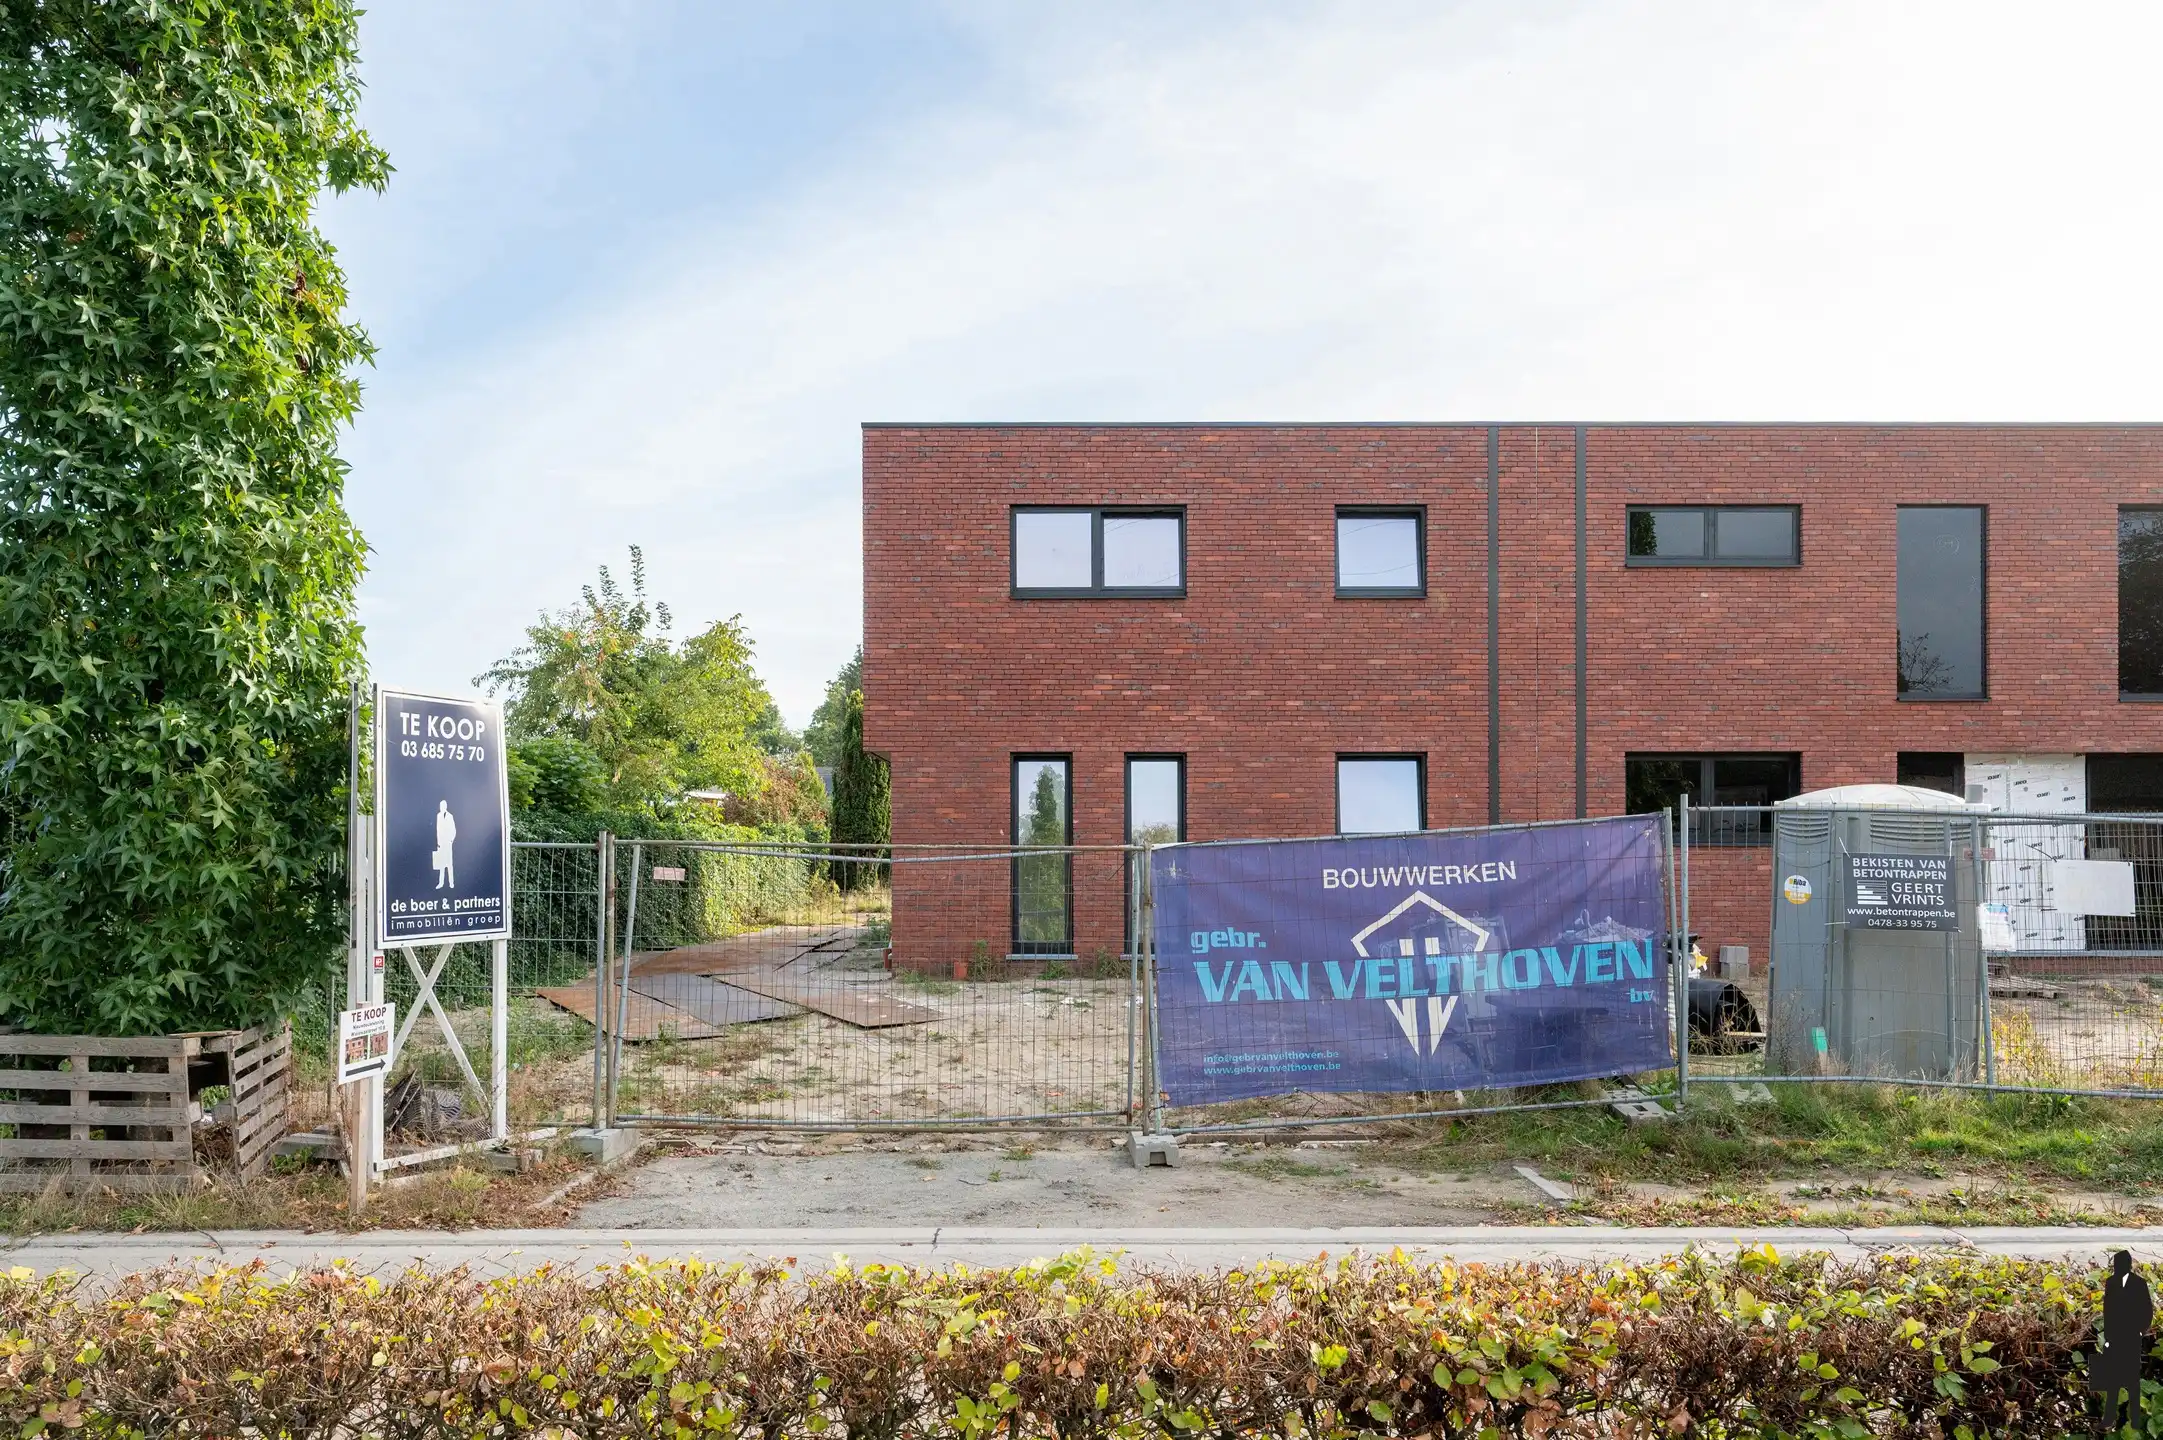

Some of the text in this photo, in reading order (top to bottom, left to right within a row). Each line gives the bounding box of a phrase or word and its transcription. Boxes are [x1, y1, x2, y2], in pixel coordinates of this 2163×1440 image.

[400, 712, 486, 741] TE KOOP
[401, 740, 485, 762] 03 685 75 70
[1852, 857, 1946, 870] BEKISTEN VAN
[1322, 860, 1518, 890] BOUWWERKEN
[1853, 868, 1947, 881] BETONTRAPPEN
[1891, 882, 1945, 895] GEERT
[391, 896, 501, 913] de boer & partners
[1891, 894, 1946, 906] VRINTS
[1847, 907, 1956, 918] www.betontrappen.be
[467, 915, 501, 927] groep
[1868, 918, 1937, 929] 0478-33 95 75
[1190, 926, 1267, 954] gebr.
[1192, 938, 1654, 1003] VAN VELTHOVEN
[351, 1006, 387, 1023] TE KOOP
[1203, 1050, 1340, 1064] info@gebrvanvelthoven.be
[1203, 1061, 1341, 1075] www.gebrvanvelthoven.be
